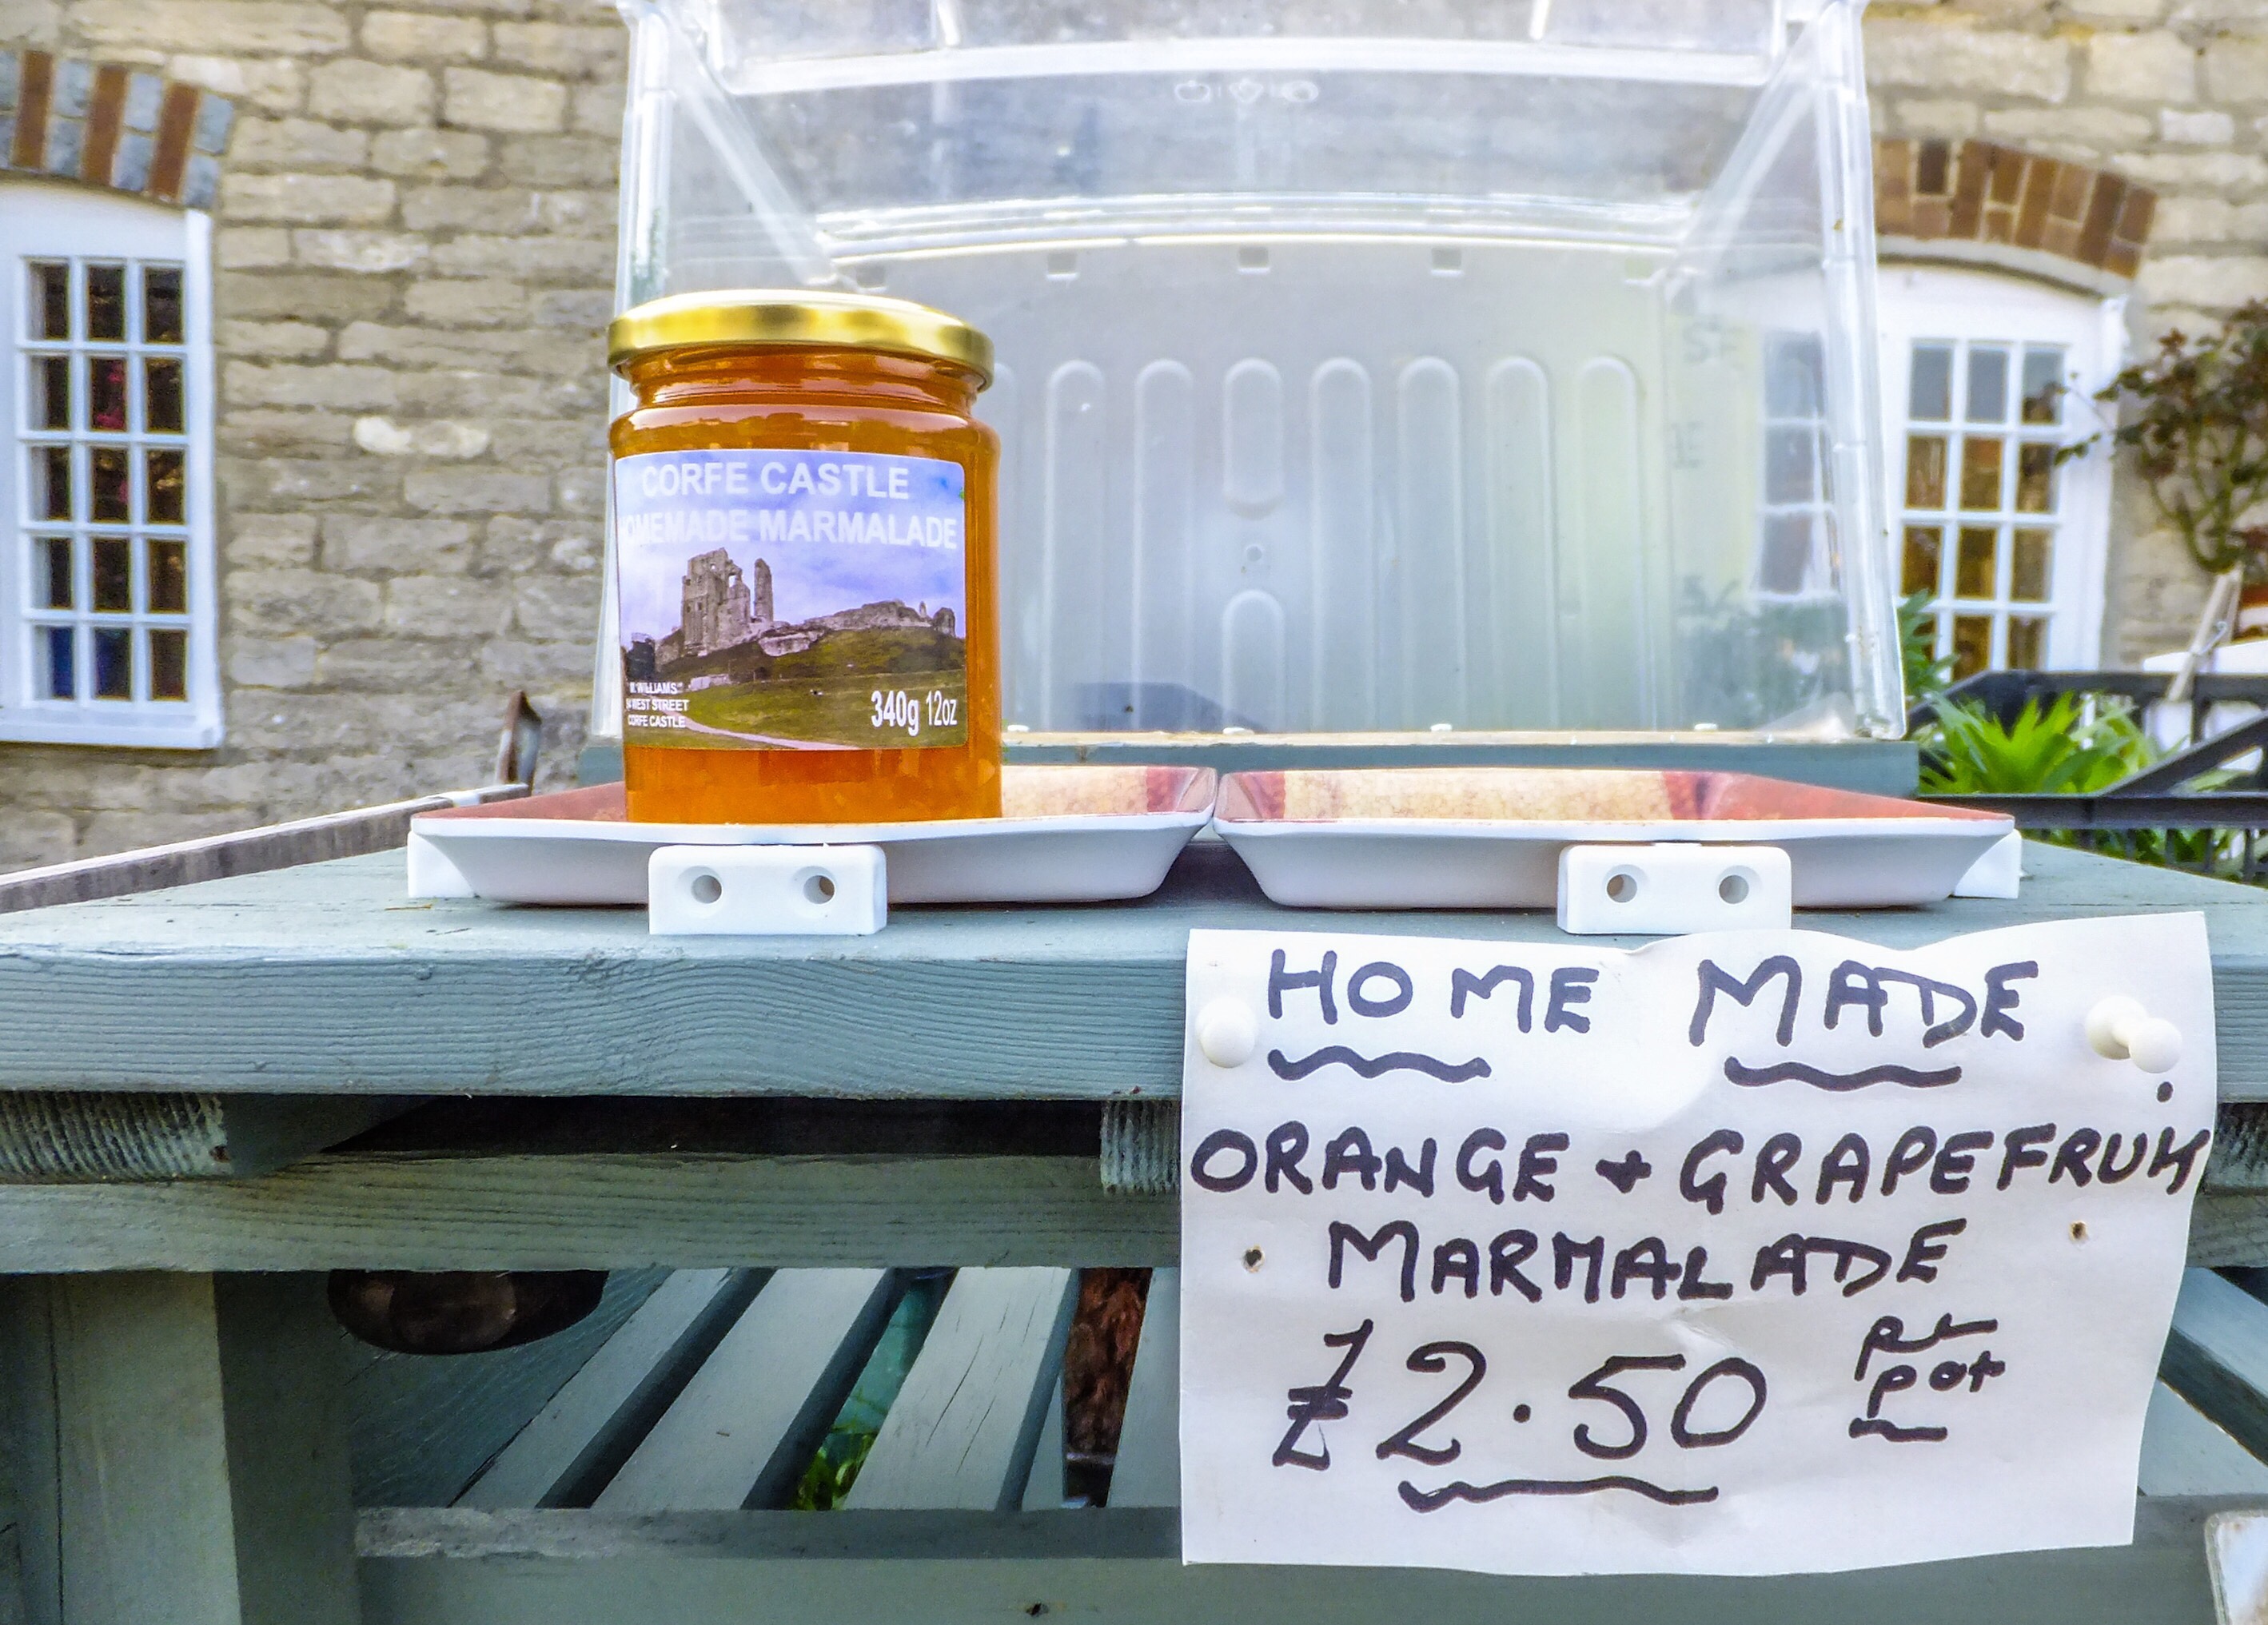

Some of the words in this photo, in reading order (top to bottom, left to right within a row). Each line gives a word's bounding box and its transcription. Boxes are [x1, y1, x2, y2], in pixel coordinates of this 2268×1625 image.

[642, 462, 749, 498] CORFE
[760, 462, 909, 500] CASTLE
[759, 510, 957, 550] MARMALADE
[649, 715, 687, 728] CASTLE
[652, 699, 690, 711] STREET
[871, 690, 920, 736] 340g
[926, 690, 958, 726] 12oz
[1267, 948, 1600, 1034] HOME
[1688, 954, 2039, 1049] MADE
[1189, 1119, 1571, 1206] ORANGE
[1327, 1217, 1968, 1304] MARMALADE
[1271, 1317, 1768, 1472] £2.50
[1865, 1349, 2007, 1420] pot
